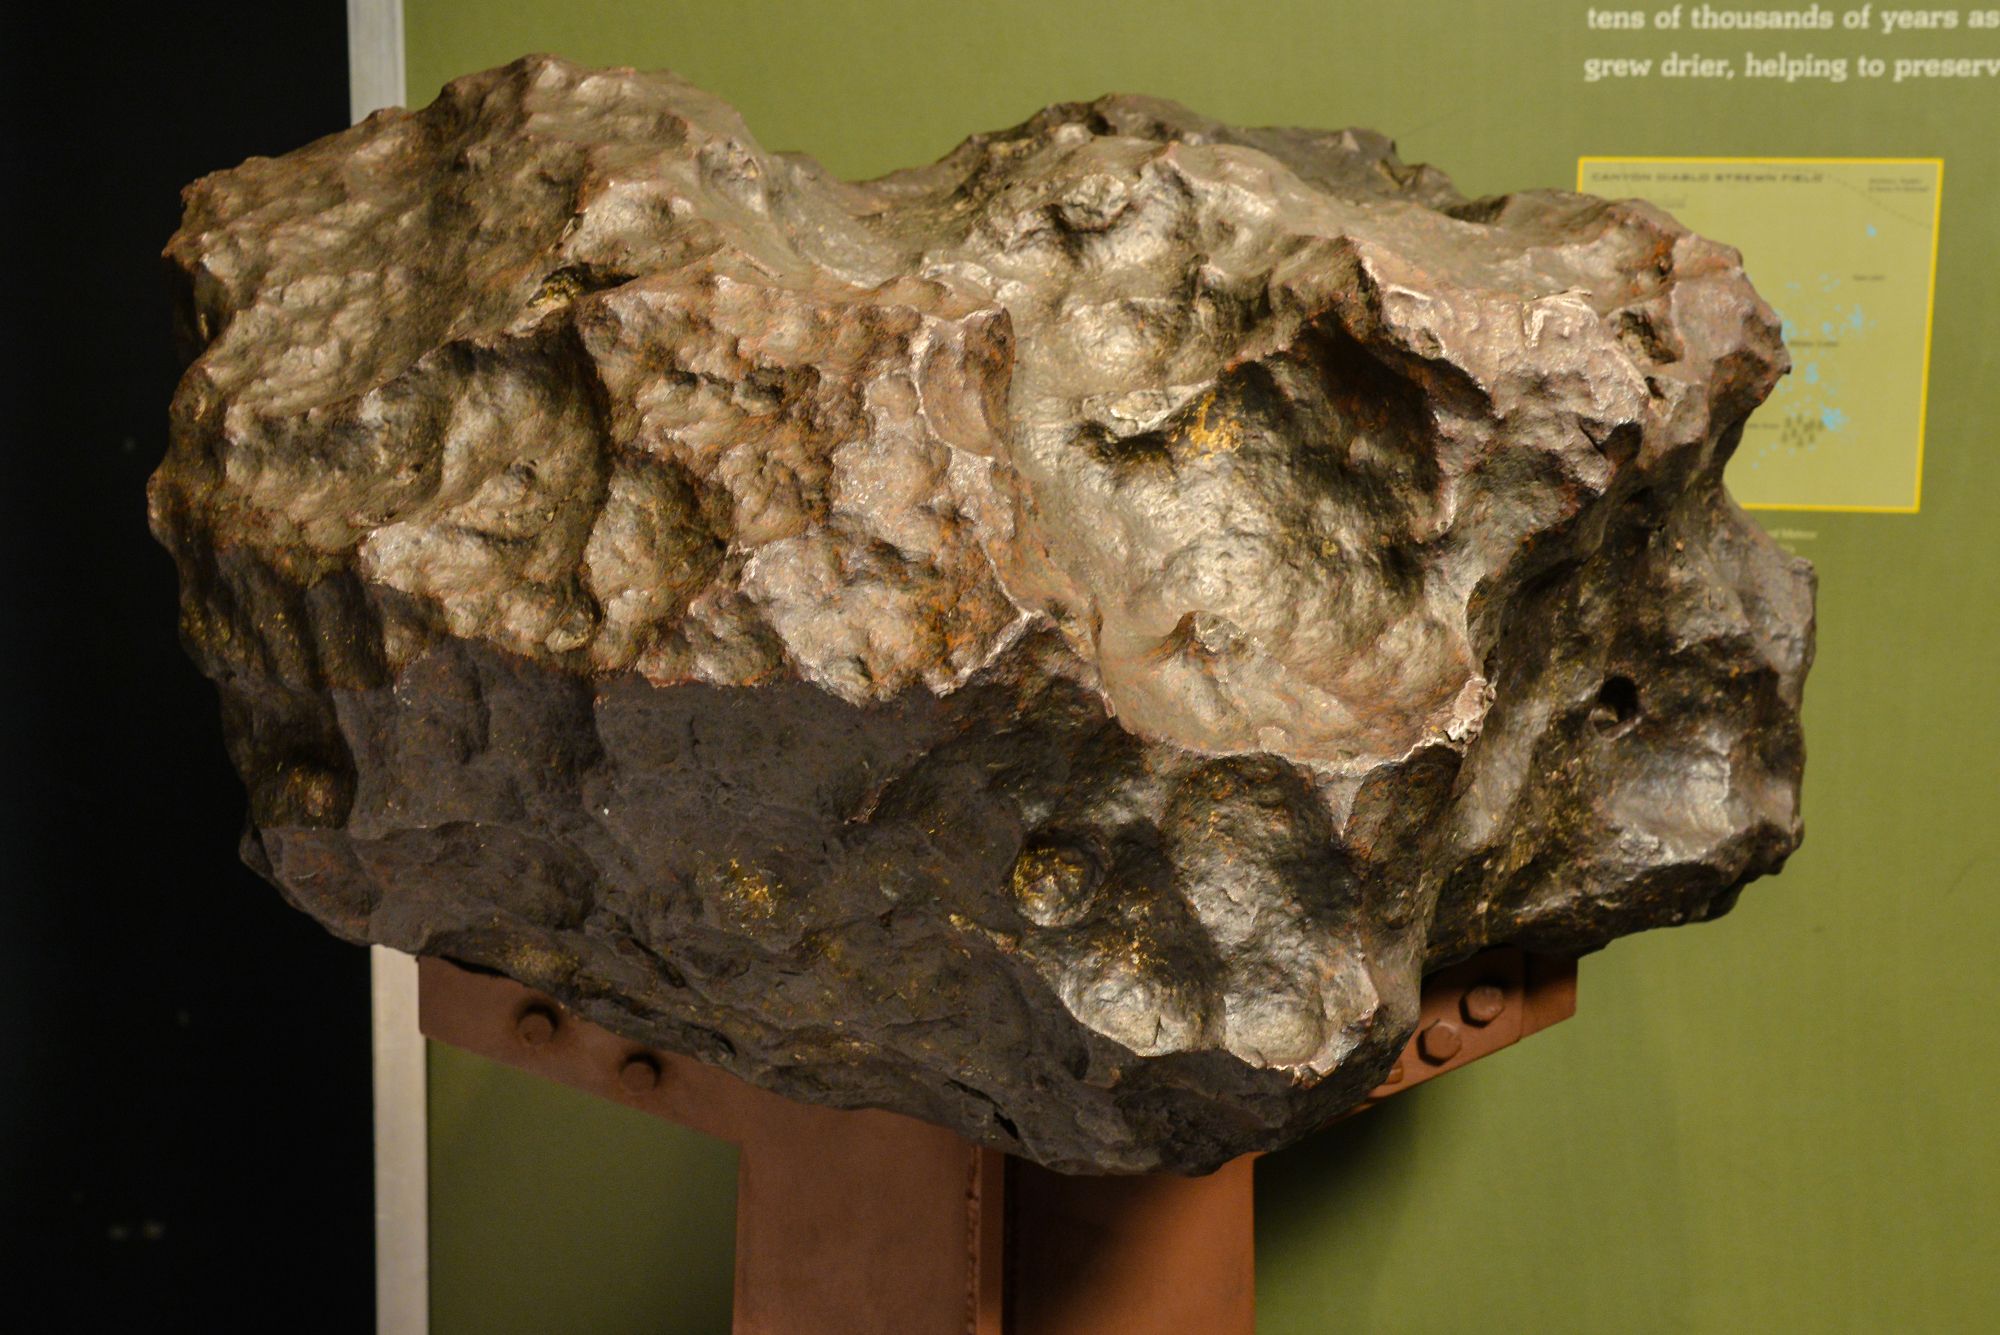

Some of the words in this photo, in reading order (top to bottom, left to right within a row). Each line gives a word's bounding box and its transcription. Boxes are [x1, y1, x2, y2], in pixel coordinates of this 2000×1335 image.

[1587, 7, 1645, 29] tens
[1653, 3, 1682, 29] of
[1691, 2, 1834, 29] thousands
[1842, 3, 1873, 29] of
[1880, 10, 1959, 34] years
[1967, 10, 2000, 29] as
[1584, 57, 1652, 82] grew
[1660, 51, 1735, 80] drier,
[1744, 51, 1847, 82] helping
[1857, 55, 1885, 77] to
